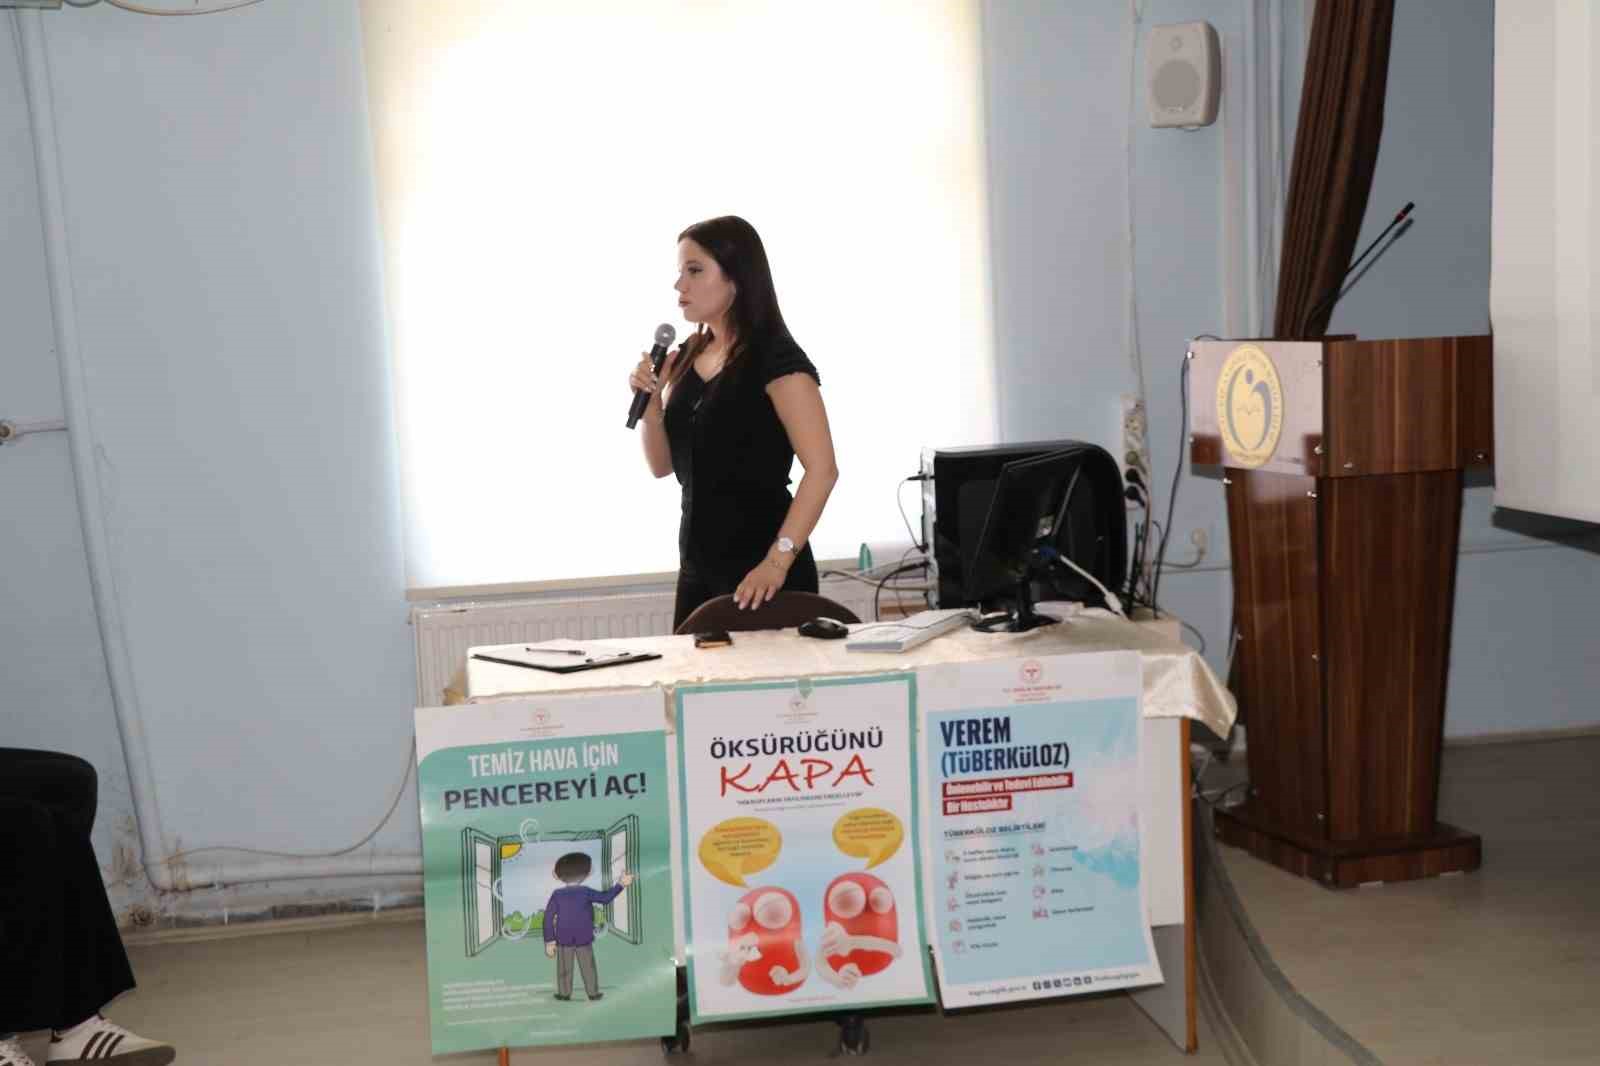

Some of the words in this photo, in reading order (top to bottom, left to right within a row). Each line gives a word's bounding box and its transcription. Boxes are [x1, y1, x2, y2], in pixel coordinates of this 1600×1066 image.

[710, 726, 883, 759] ÖKSÜRÜĞÜNÜ
[940, 716, 1011, 747] VEREM
[468, 748, 525, 777] TEMİZ
[529, 746, 578, 772] HAVA
[583, 741, 619, 771] İÇİN
[720, 754, 875, 797] KAPA
[444, 772, 597, 811] PENCEREYİ
[604, 772, 647, 799] AÇ!
